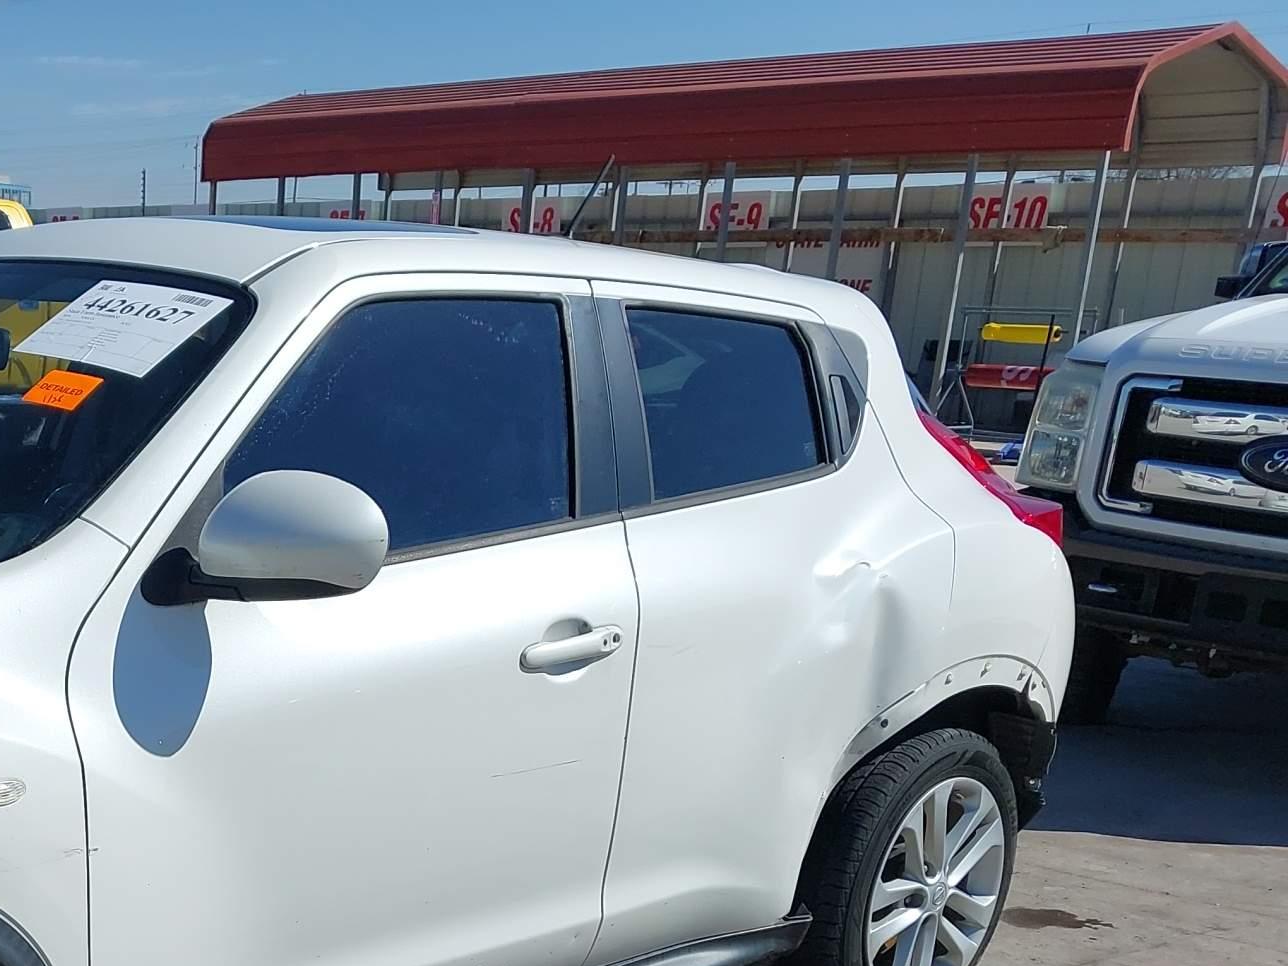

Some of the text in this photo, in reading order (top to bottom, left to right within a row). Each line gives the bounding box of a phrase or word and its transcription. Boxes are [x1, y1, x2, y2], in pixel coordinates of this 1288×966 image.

[508, 207, 554, 232] S-8
[83, 296, 196, 325] 44261627
[40, 383, 83, 396] DETAILED
